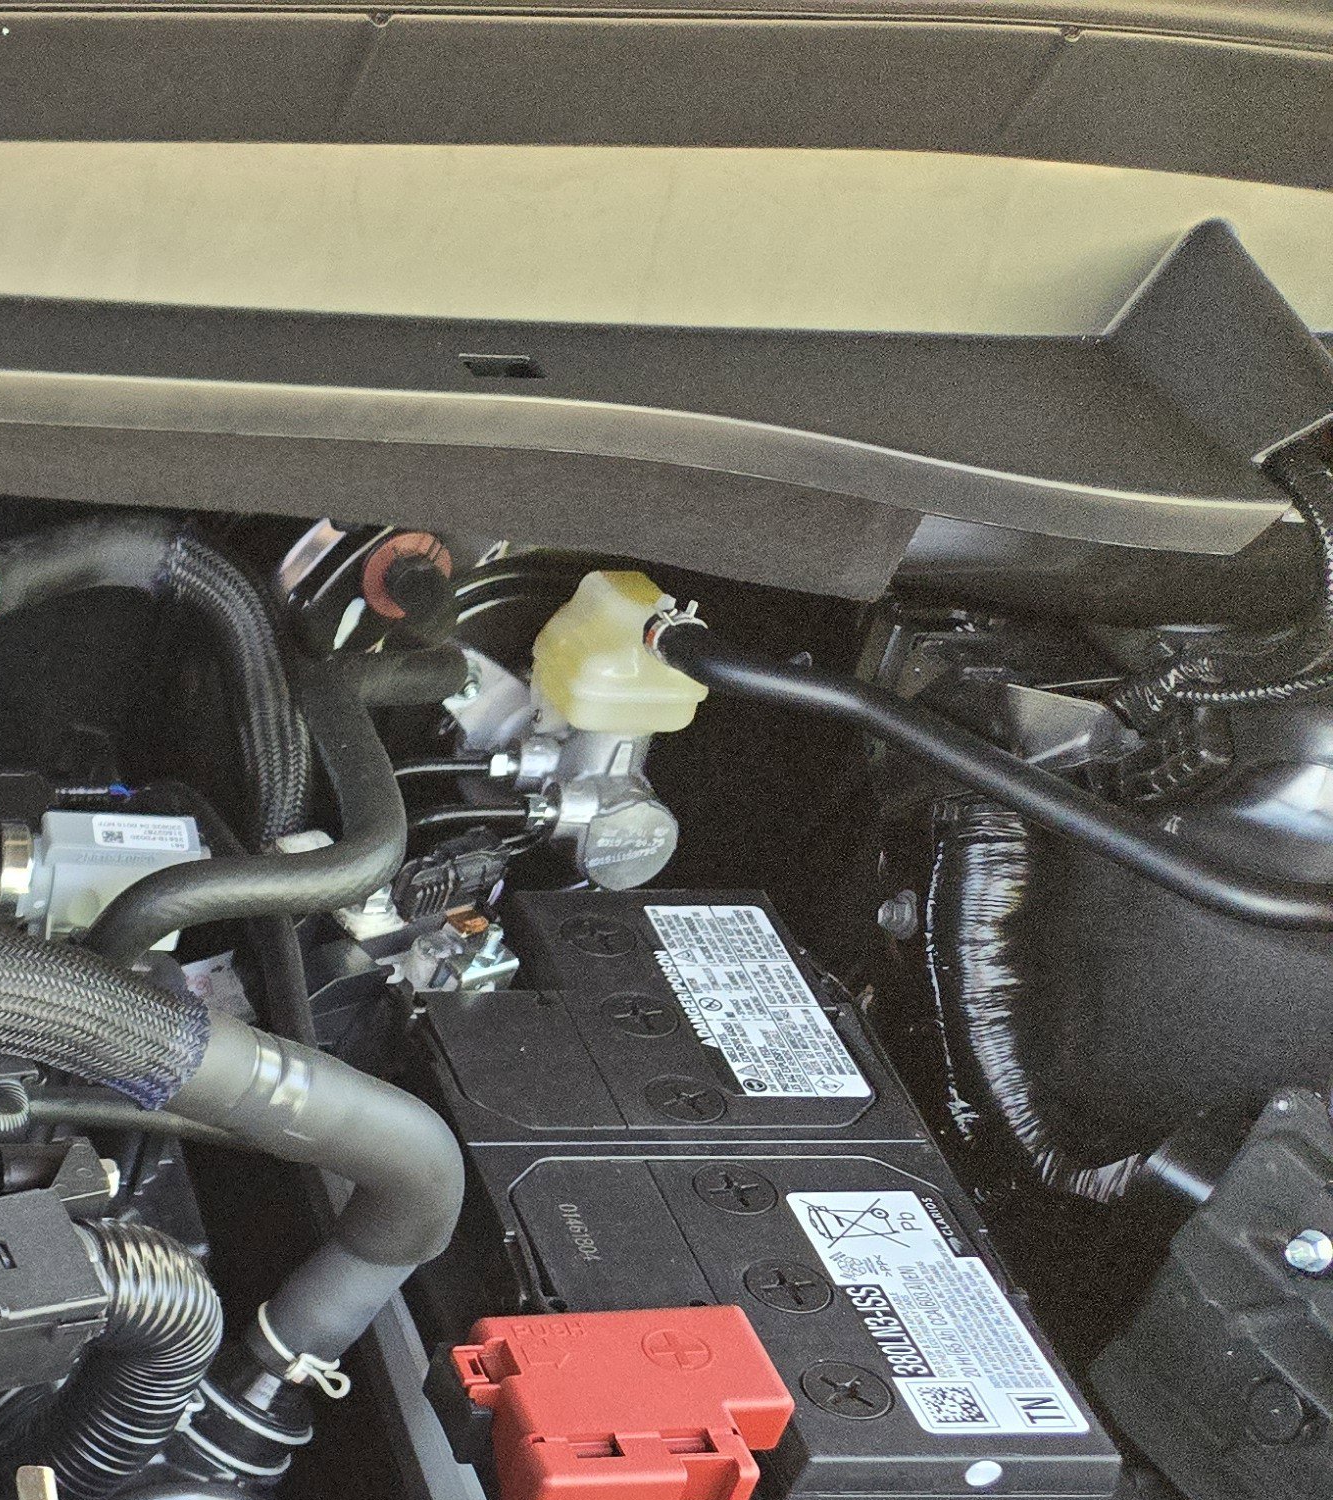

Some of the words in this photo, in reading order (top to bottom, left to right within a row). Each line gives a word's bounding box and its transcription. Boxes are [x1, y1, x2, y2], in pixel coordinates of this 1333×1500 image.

[896, 1210, 923, 1233] Pb
[921, 1196, 956, 1237] CLARIOS
[845, 1285, 933, 1378] 380LN3-ISS
[1013, 1395, 1064, 1426] TN
